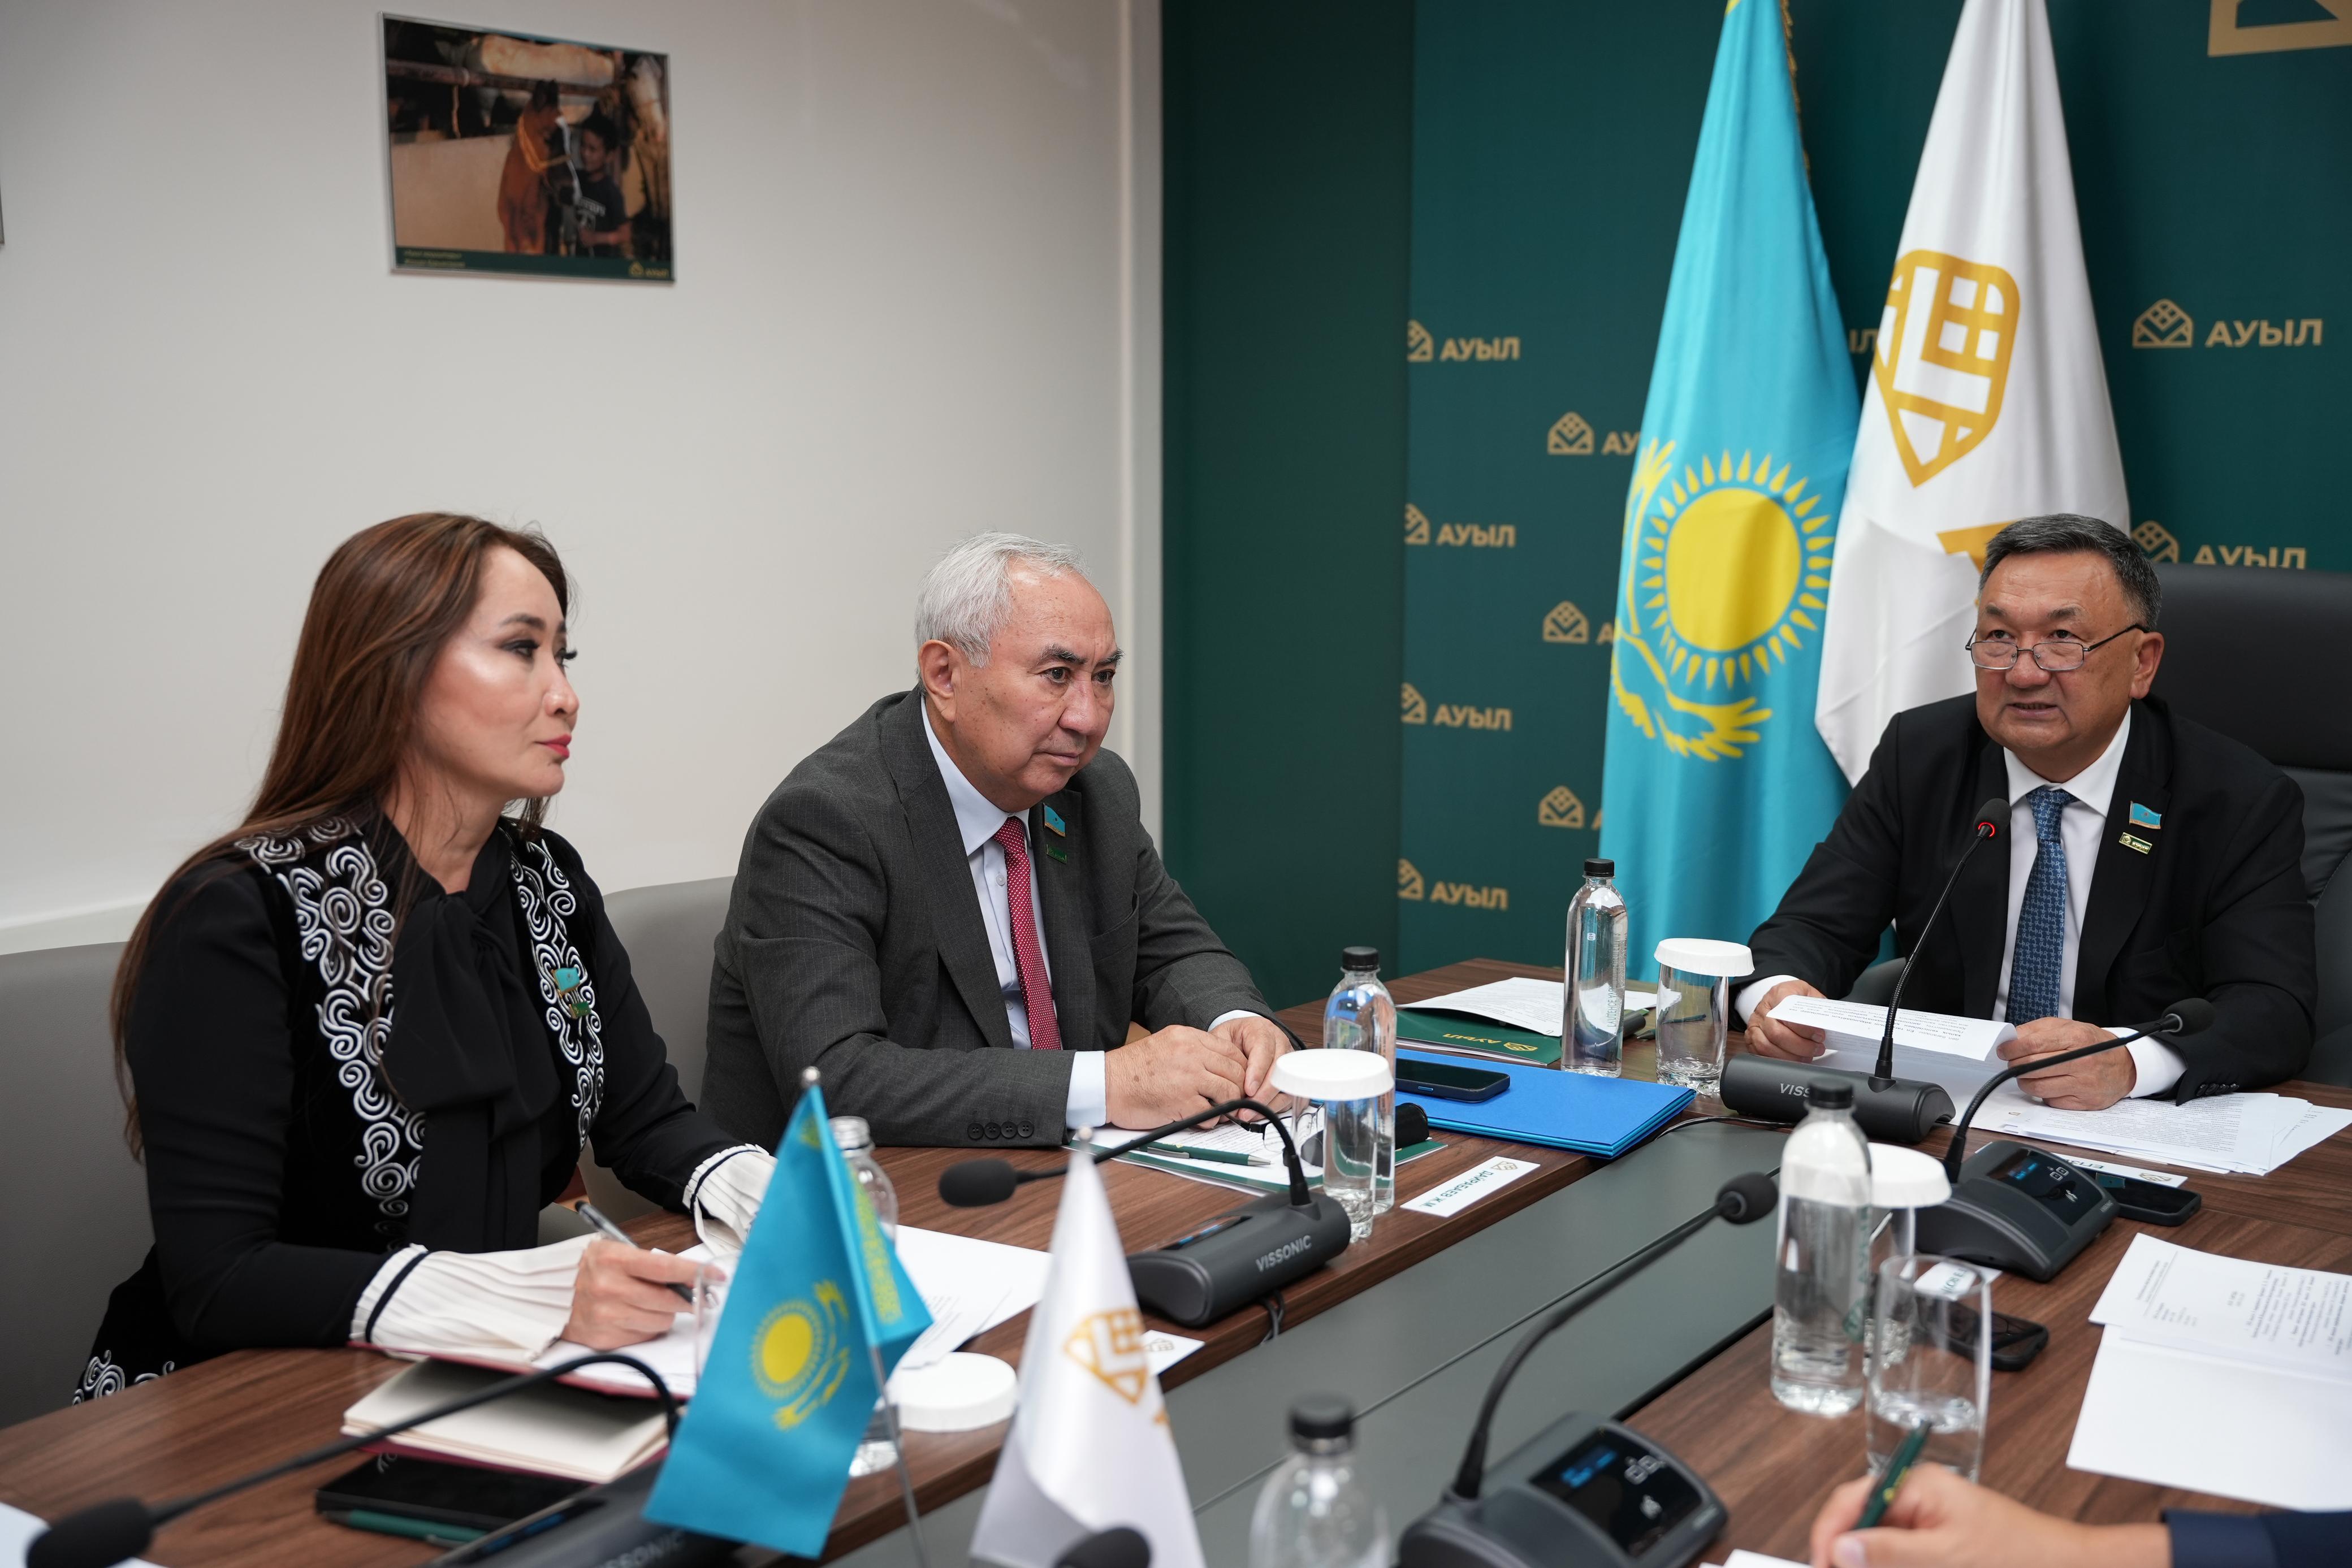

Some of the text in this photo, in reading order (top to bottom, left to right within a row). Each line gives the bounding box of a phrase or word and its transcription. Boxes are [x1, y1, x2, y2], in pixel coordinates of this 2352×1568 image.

[2206, 319, 2323, 347] АУЫЛ
[1440, 337, 1520, 361] АУЫЛ
[1602, 432, 1641, 454] АУ
[1437, 523, 1516, 547] АУЫЛ
[2194, 545, 2307, 570] АУЫЛ
[1433, 704, 1512, 730] АУЫЛ
[1430, 882, 1508, 909] АУЫЛ
[1443, 1033, 1502, 1044] АУЫЛ
[1780, 1083, 1810, 1098] VISS
[2067, 1159, 2104, 1169] ЕГІЗ
[1441, 1170, 1494, 1197] ДАЙРАБАЕВ
[1256, 1235, 1311, 1272] VISSONIC
